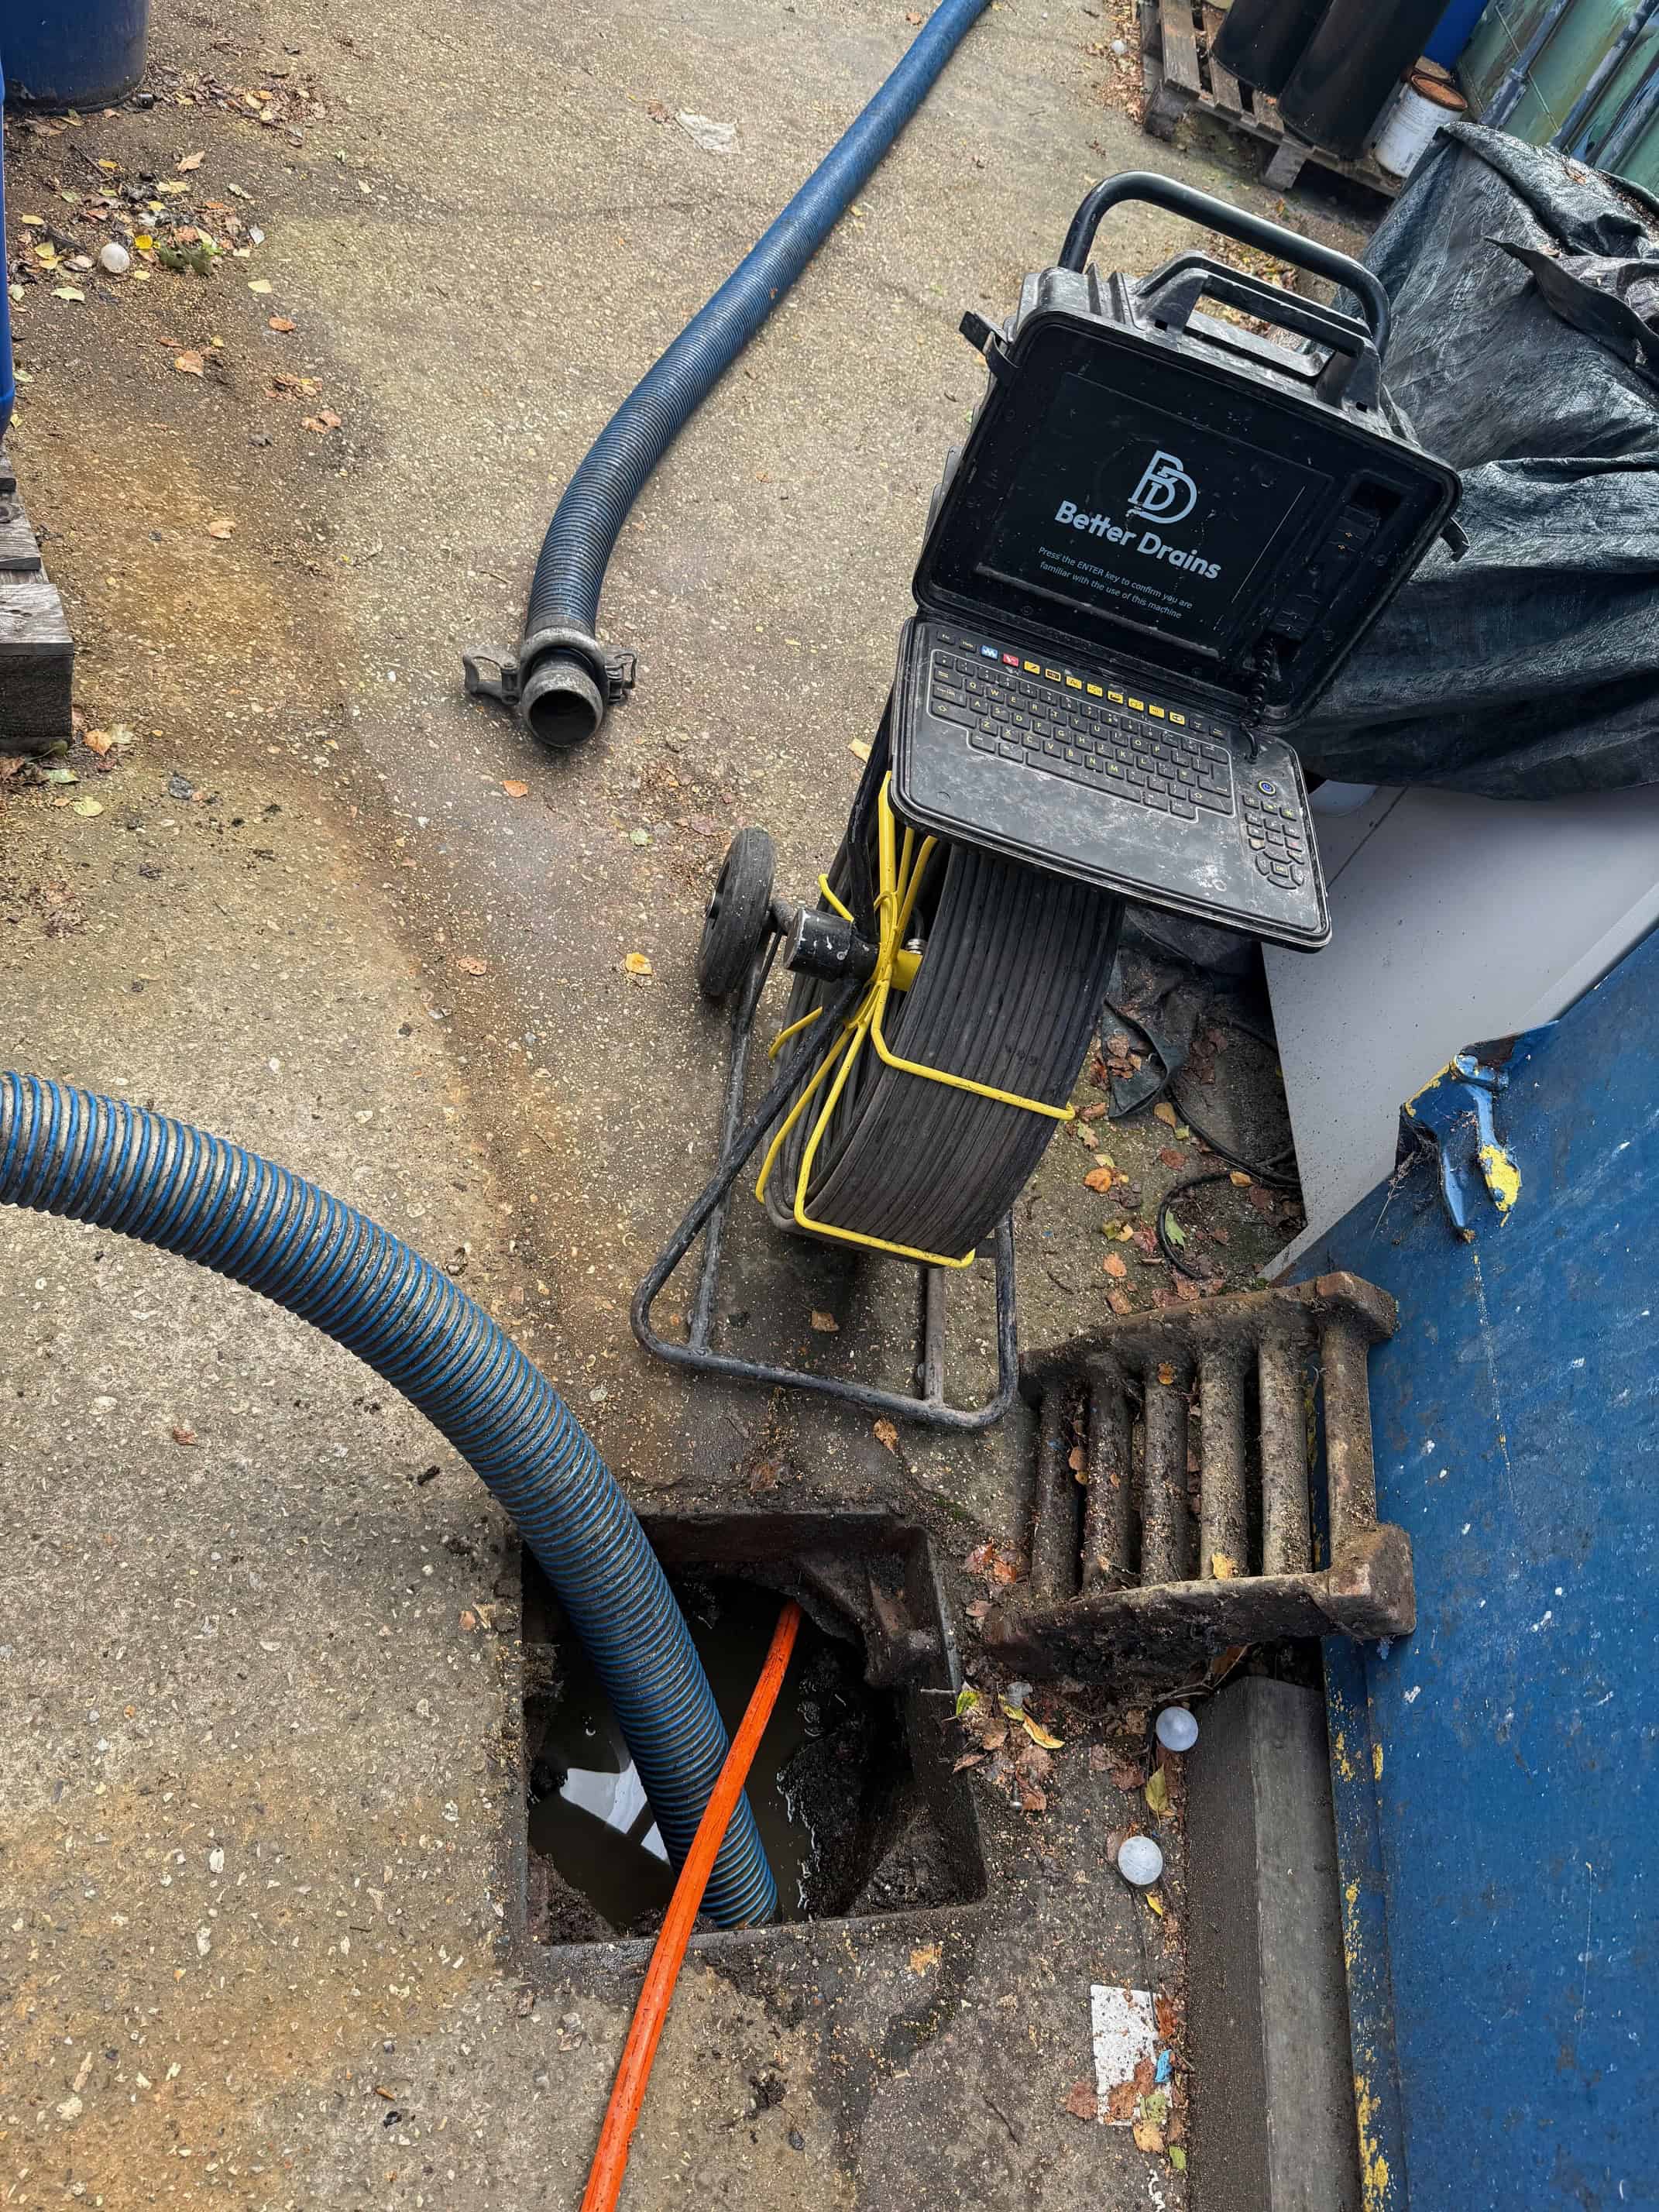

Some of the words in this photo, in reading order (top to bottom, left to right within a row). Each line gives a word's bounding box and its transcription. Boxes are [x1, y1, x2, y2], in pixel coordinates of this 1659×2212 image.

[1054, 500, 1137, 545] Better
[1137, 532, 1221, 579] Drains
[1039, 546, 1060, 561] Press
[1062, 555, 1076, 566] the
[1077, 561, 1104, 577] ENTER
[1104, 571, 1121, 583] key
[1132, 582, 1162, 597] confirm
[1162, 592, 1177, 604] you
[1179, 599, 1193, 609] are
[1040, 562, 1071, 578] familiar
[1072, 574, 1090, 586] with
[1091, 580, 1104, 591] the
[1106, 588, 1121, 596] use
[1121, 591, 1131, 600] of
[1131, 595, 1146, 606] this
[1148, 602, 1182, 619] machine
